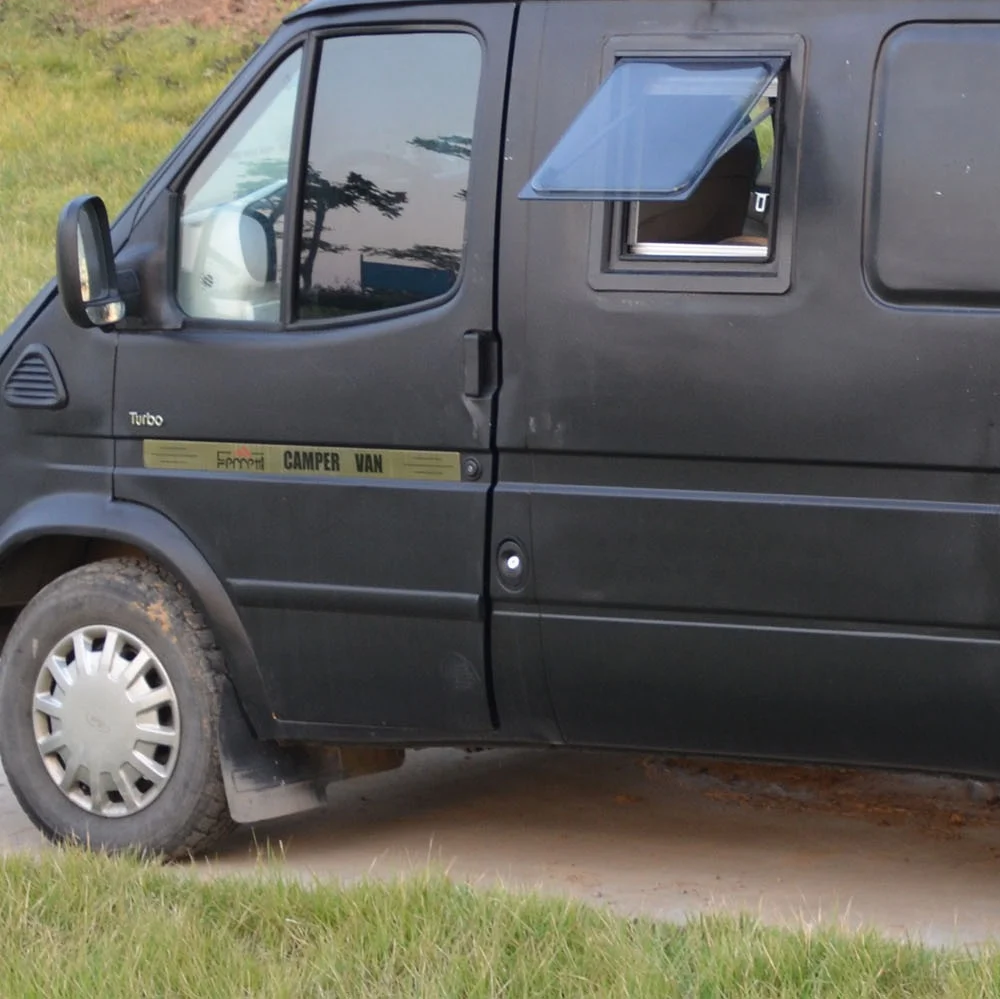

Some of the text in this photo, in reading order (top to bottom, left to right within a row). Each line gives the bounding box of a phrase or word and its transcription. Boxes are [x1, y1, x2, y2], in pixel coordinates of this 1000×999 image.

[128, 411, 164, 427] Turbo
[283, 450, 340, 472] CAMPER
[354, 453, 384, 473] VAN
